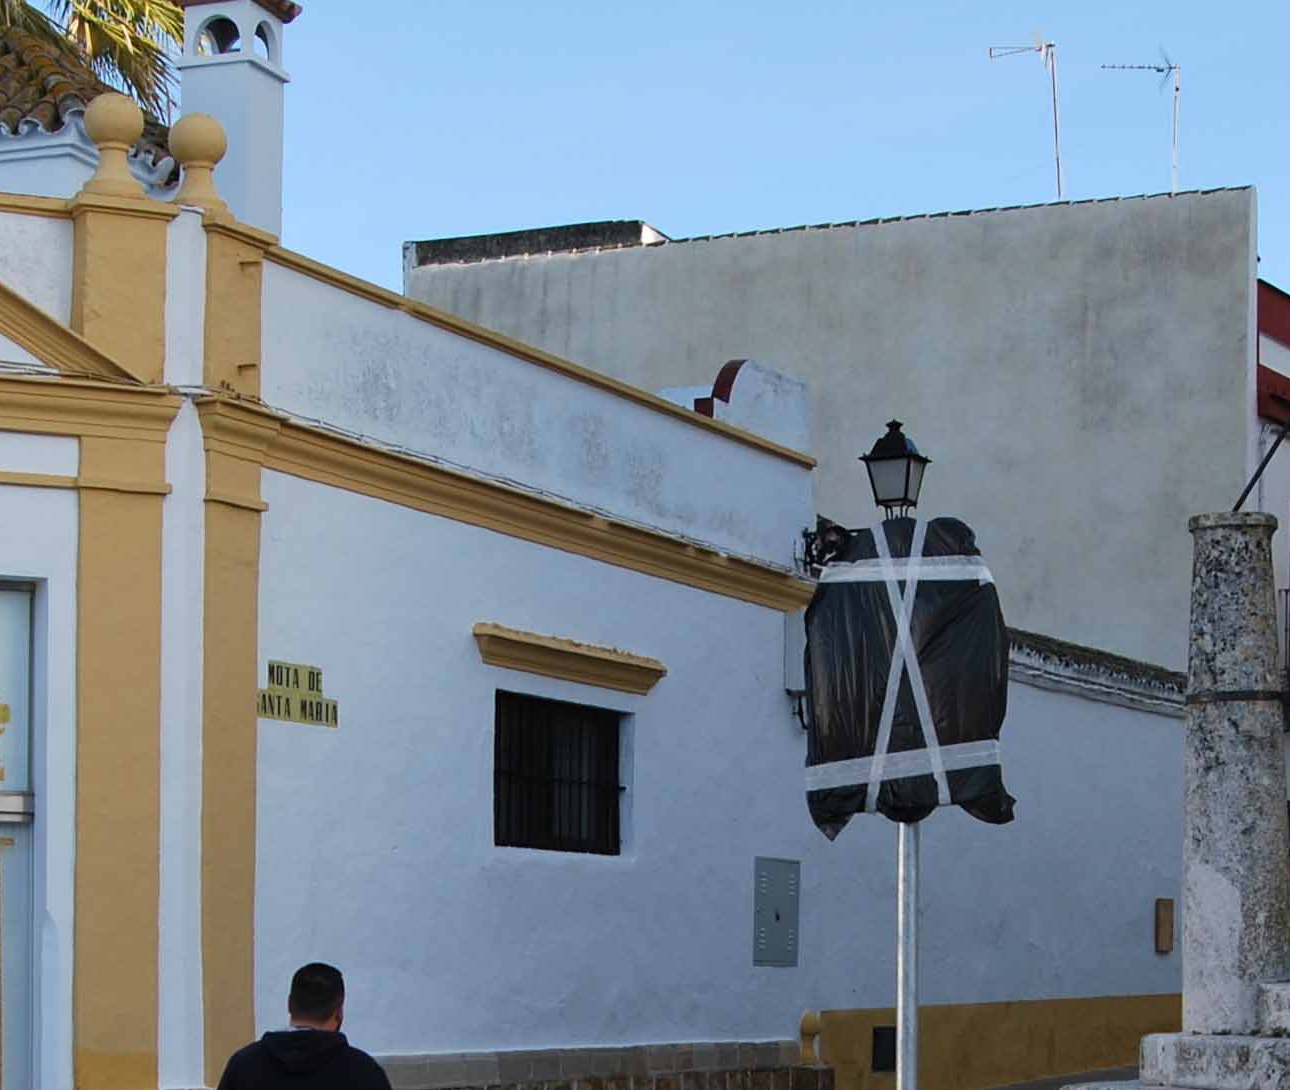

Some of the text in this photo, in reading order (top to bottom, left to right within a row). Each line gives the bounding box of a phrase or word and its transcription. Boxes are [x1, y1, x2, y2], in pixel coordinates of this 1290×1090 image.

[268, 663, 323, 693] MOTA DE
[300, 698, 338, 728] MARIA
